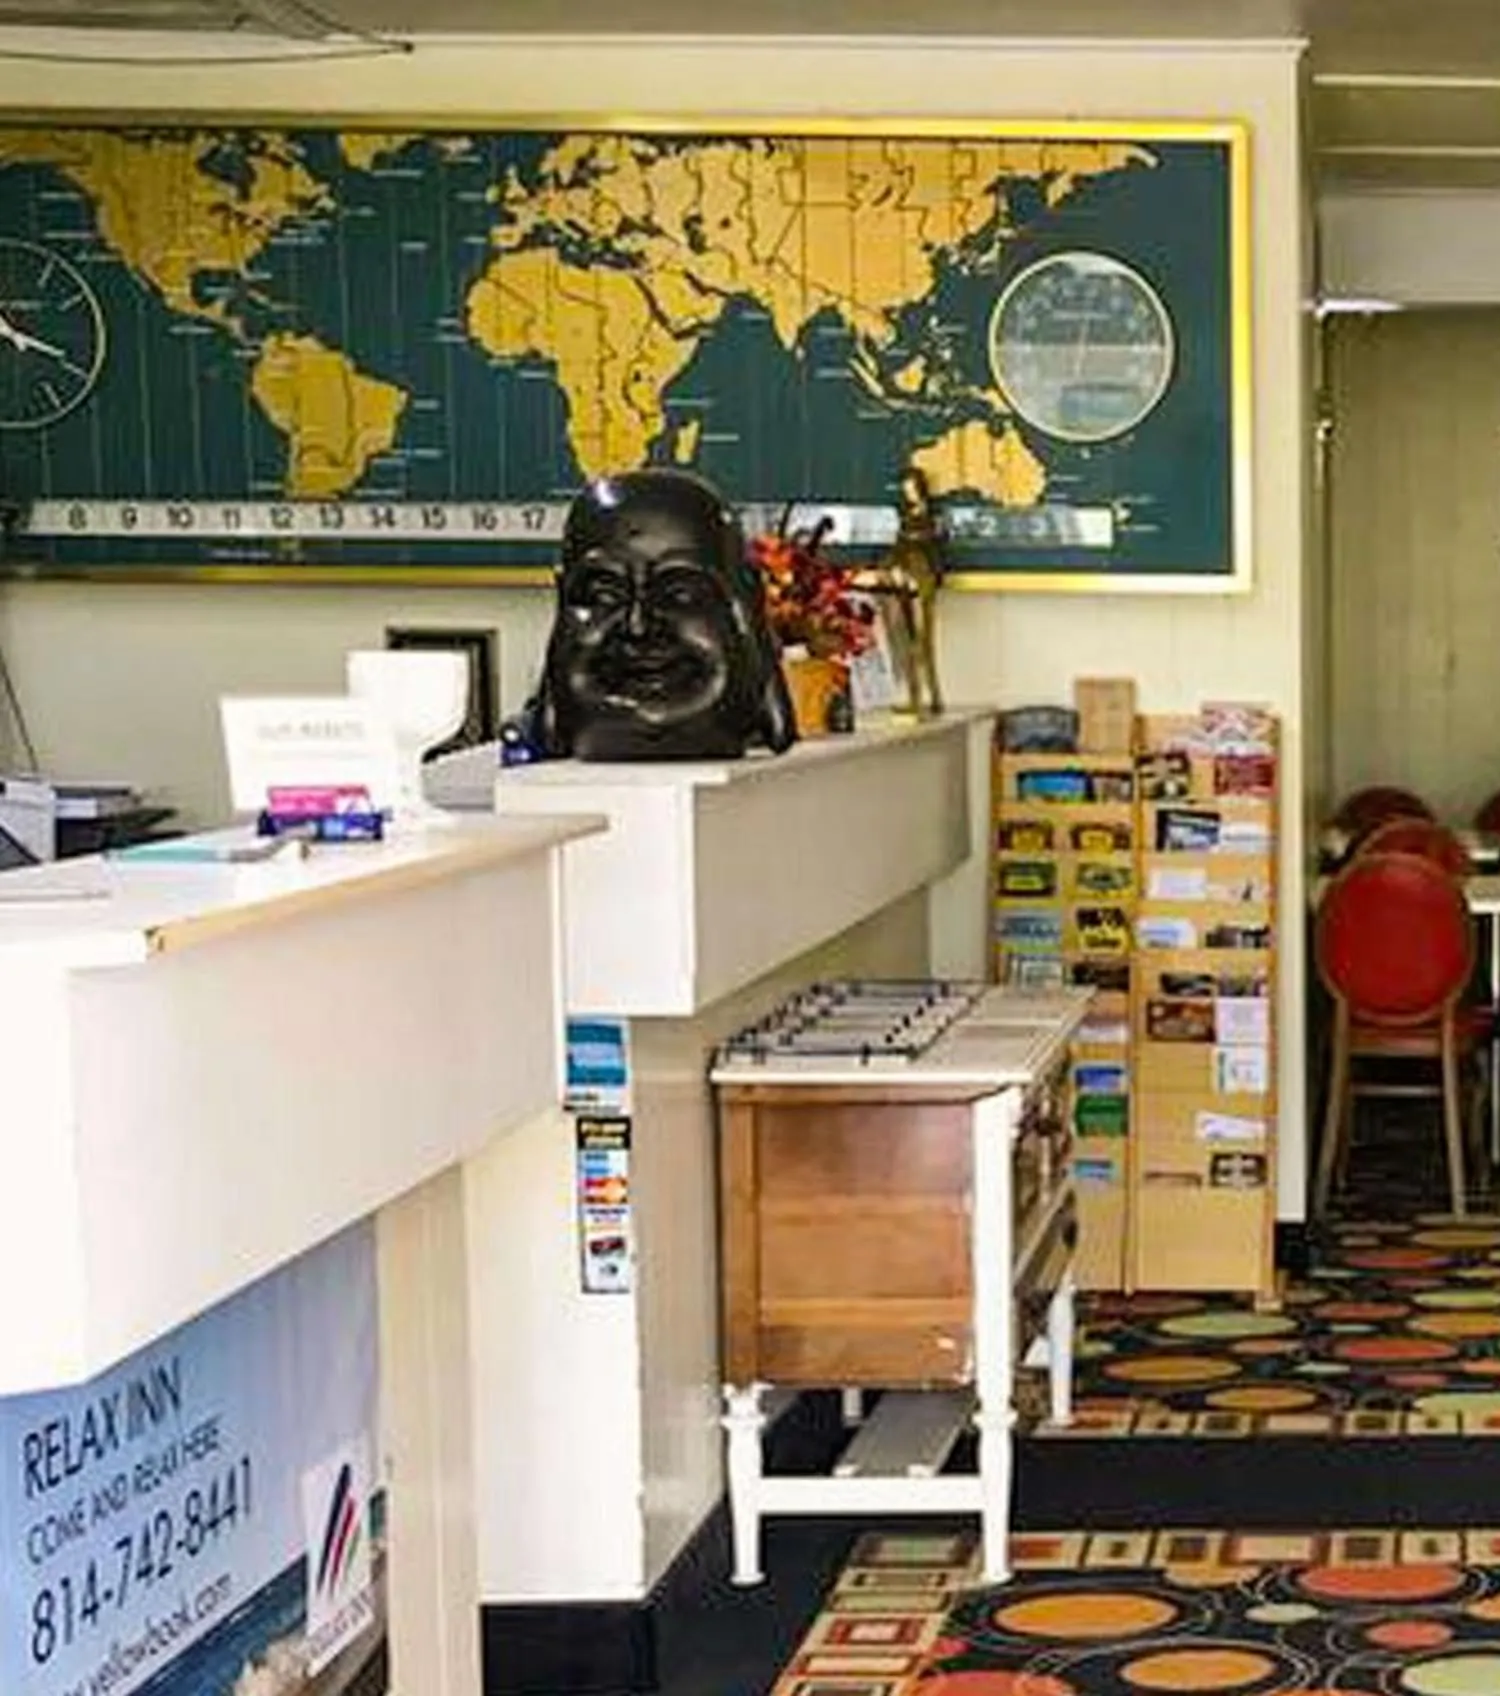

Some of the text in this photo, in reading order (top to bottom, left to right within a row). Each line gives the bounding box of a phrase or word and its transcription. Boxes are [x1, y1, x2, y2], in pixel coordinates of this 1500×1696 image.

[67, 503, 546, 531] 8 9 10 11 12 13 14 15 16 17
[23, 1354, 182, 1499] RELAX INN
[27, 1499, 86, 1566] COME
[91, 1471, 129, 1522] AND
[32, 1452, 253, 1666] 814-742-8441
